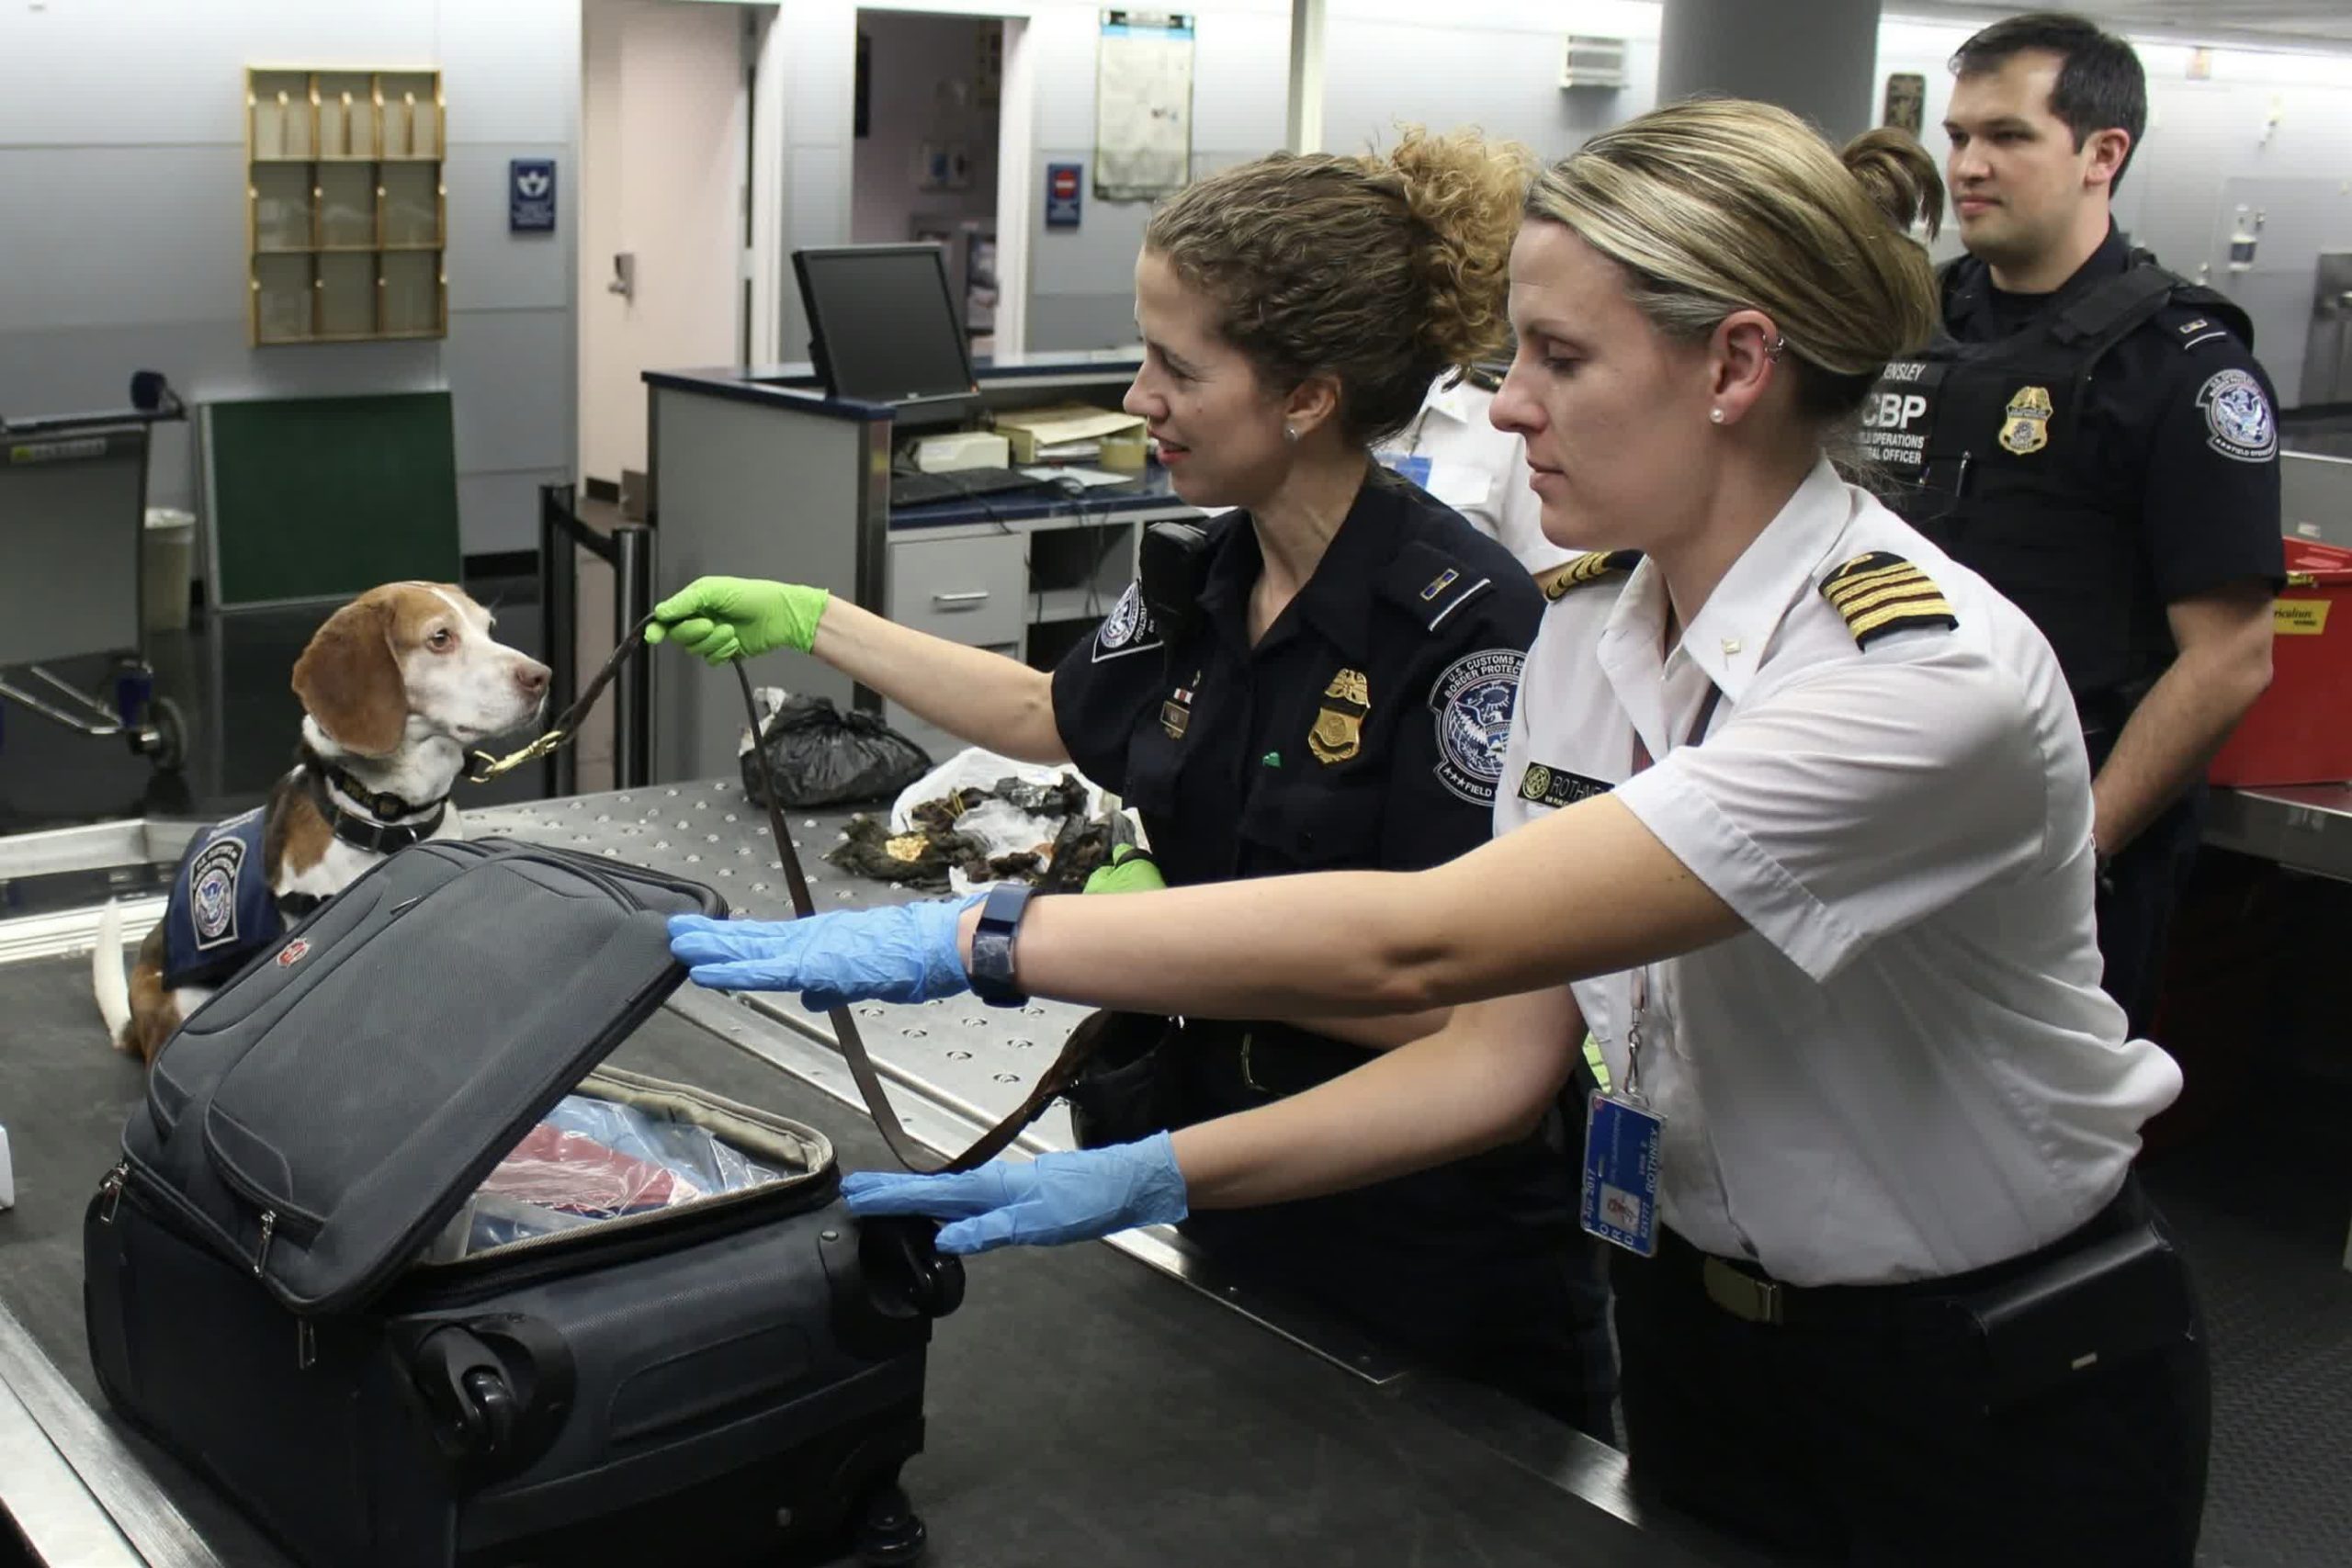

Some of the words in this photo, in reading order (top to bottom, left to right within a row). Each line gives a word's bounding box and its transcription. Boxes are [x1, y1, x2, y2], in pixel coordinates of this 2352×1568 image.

[1861, 393, 1927, 429] CBP
[1872, 433, 1925, 449] OPERATIONS
[1883, 448, 1922, 465] OFFICER
[1448, 666, 1466, 682] U.S.
[1465, 655, 1515, 671] CUSTOMS
[1444, 670, 1479, 699] BORDER
[1464, 782, 1493, 797] FIELD
[1645, 1126, 1659, 1194] ROTHNEY
[1587, 1168, 1597, 1195] 2017
